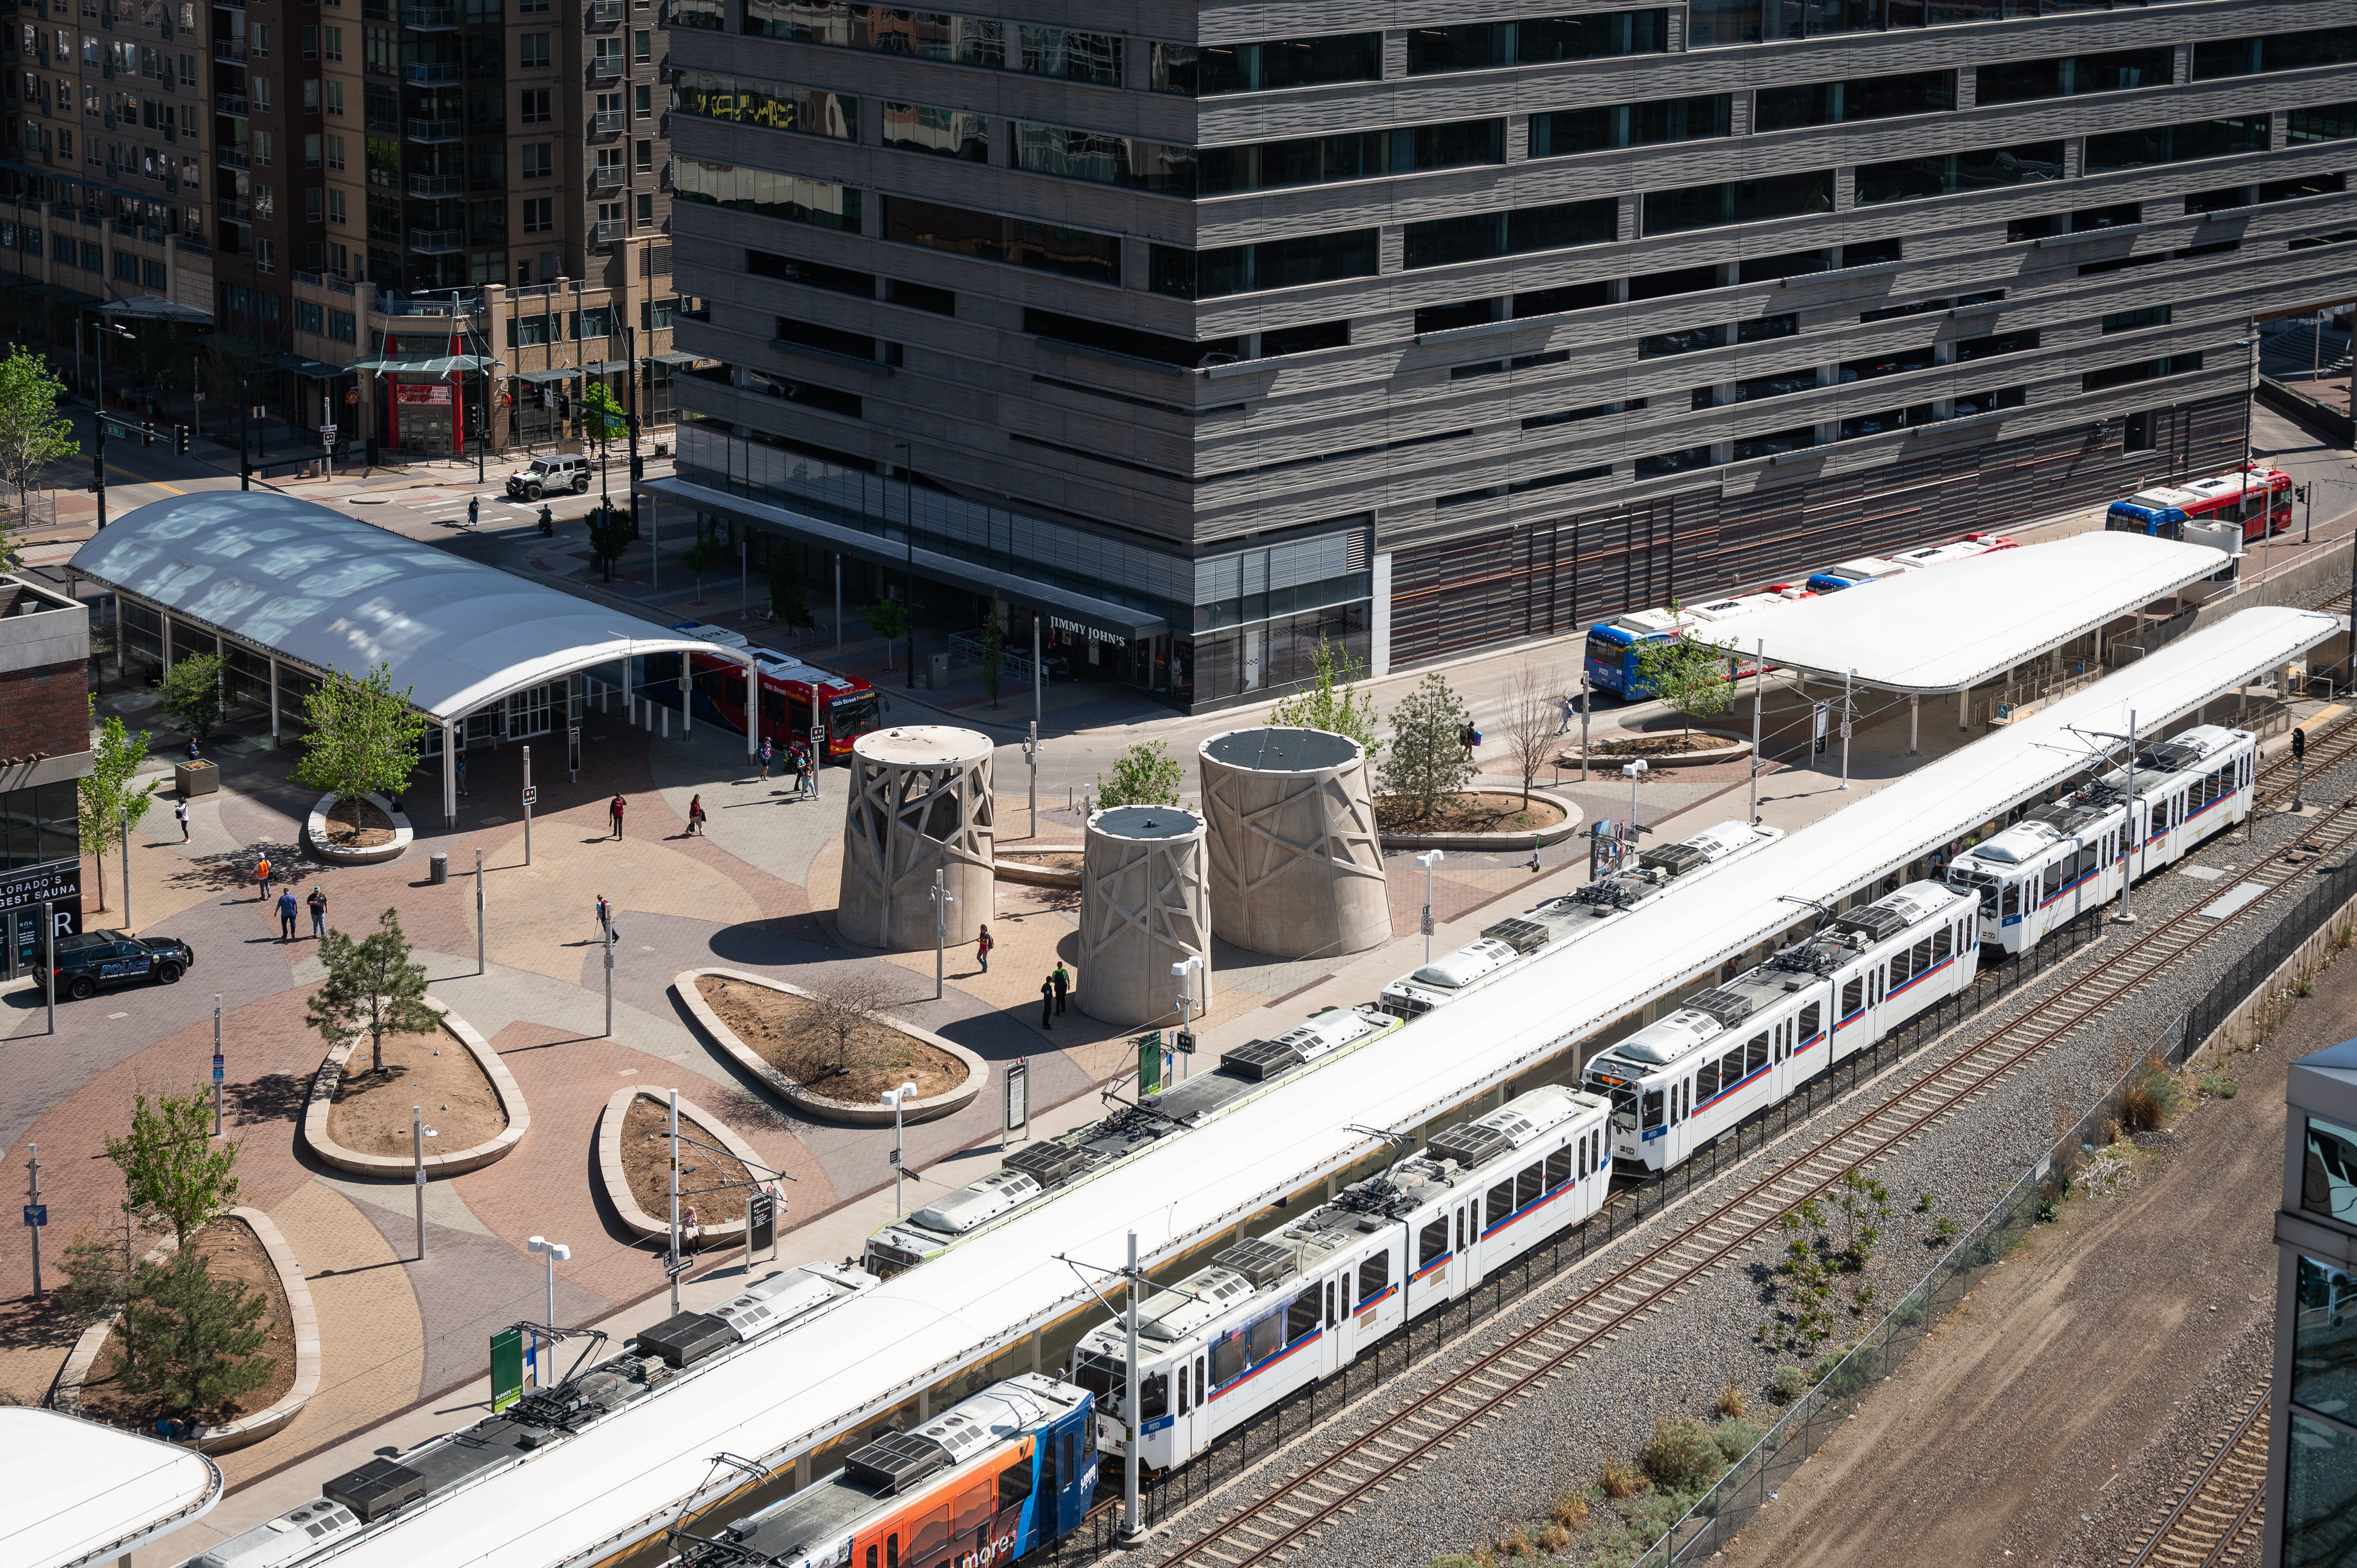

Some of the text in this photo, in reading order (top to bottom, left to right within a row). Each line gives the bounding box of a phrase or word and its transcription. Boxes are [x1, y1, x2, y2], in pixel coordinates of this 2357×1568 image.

[398, 385, 432, 394] BLAZING
[408, 394, 430, 403] BIRD
[2129, 518, 2147, 526] FreeRide
[701, 630, 728, 641] 166
[1050, 616, 1125, 647] JIMMY JOHN'S
[1595, 639, 1607, 648] Street
[1607, 642, 1625, 653] FreeRide
[1599, 667, 1608, 675] RTD
[764, 682, 806, 702] 16th Street FreeRide
[856, 692, 875, 701] FreeRide
[0, 876, 61, 896] LORADO'S
[0, 884, 75, 907] GEST SAUNA
[54, 912, 73, 938] R
[100, 959, 151, 976] POLICE
[1602, 1075, 1623, 1086] RIDGEGATE
[1141, 1084, 1153, 1092] ELEVATE
[1648, 1130, 1658, 1138] RTD
[753, 1200, 763, 1209] LIGHT
[679, 1261, 692, 1270] STATION
[495, 1389, 511, 1401] ELEVATE
[496, 1389, 520, 1404] ADVERTISING
[1148, 1422, 1160, 1431] RTD
[1081, 1463, 1096, 1487] UMB
[1081, 1473, 1096, 1495] BANK
[962, 1535, 1014, 1568] more.
